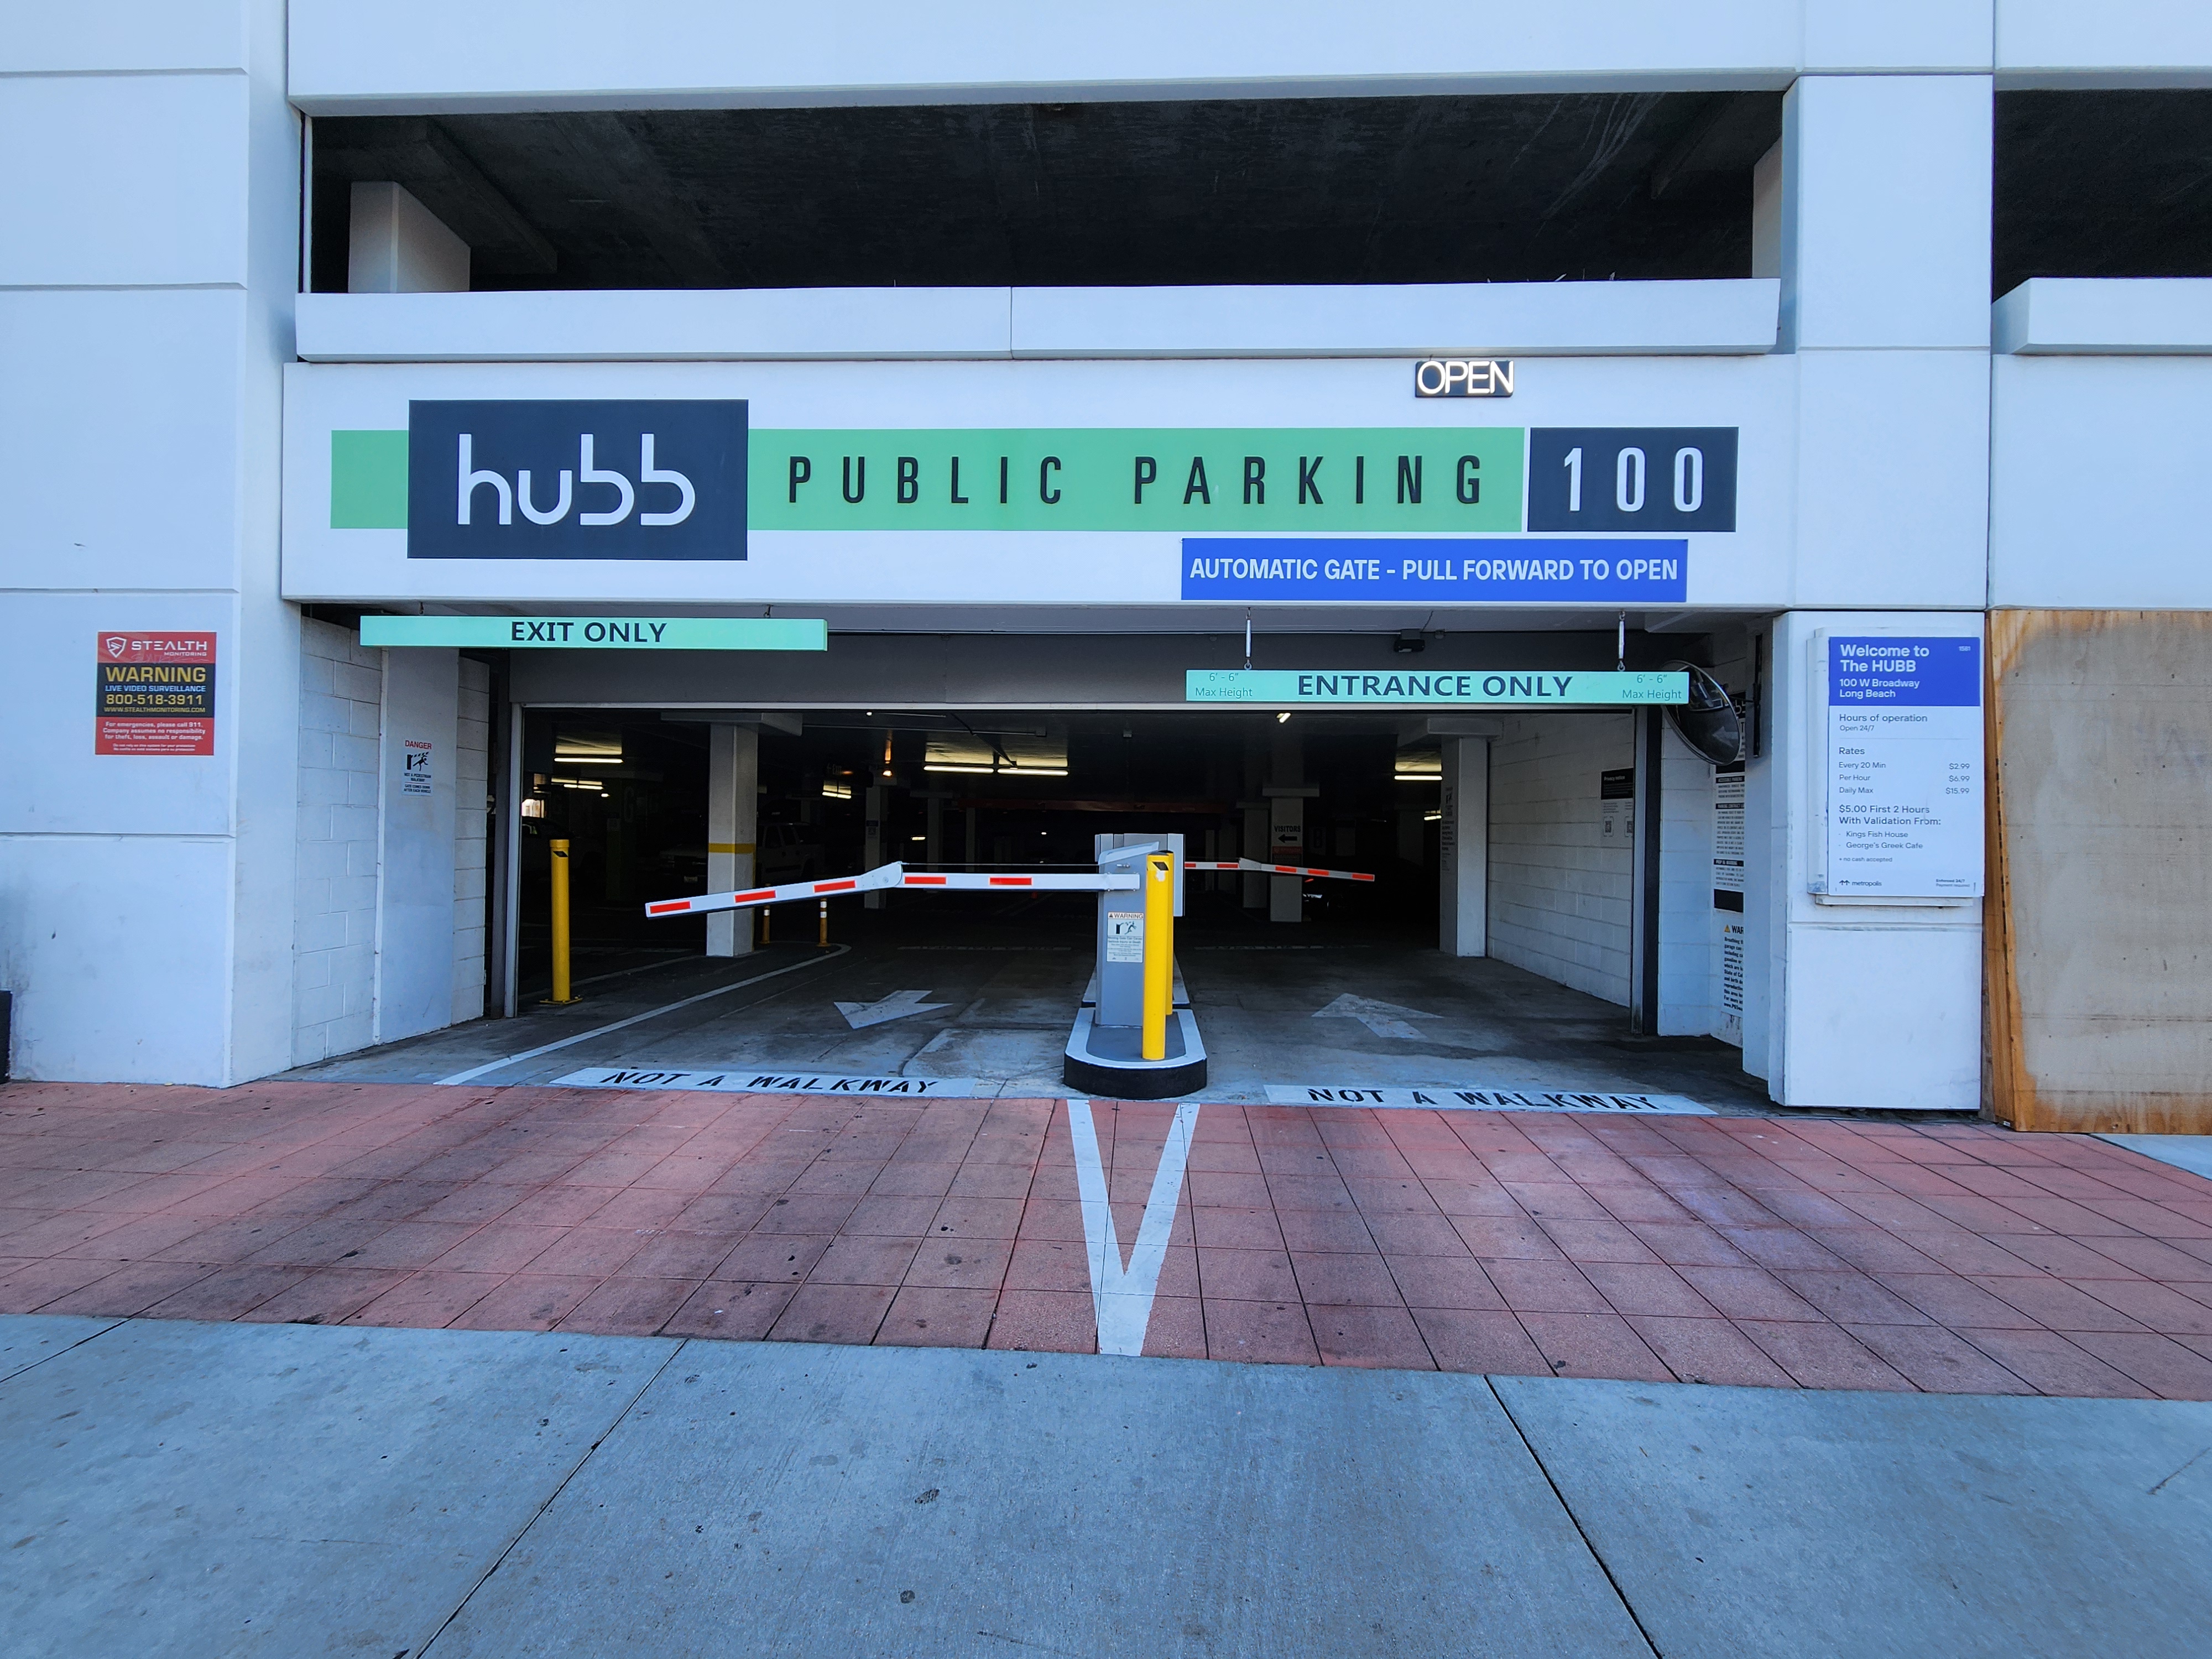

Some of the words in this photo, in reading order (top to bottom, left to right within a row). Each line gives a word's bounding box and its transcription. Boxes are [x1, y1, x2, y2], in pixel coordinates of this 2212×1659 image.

[1416, 360, 1514, 395] OPEN
[458, 433, 696, 526] hubb
[789, 456, 1062, 504] PUBLIC
[1136, 455, 1480, 504] PARKING
[1563, 447, 1703, 513] 100
[1190, 559, 1317, 580] AUTOMATIC
[1324, 559, 1380, 580] GATE
[1402, 559, 1457, 580] PULL
[1463, 559, 1574, 581] FORWARD
[1579, 560, 1610, 581] TO
[1616, 560, 1678, 581] OPEN
[511, 621, 574, 642] EXIT
[584, 622, 667, 643] ONLY
[131, 641, 207, 650] STEALTH
[1840, 645, 1910, 657] Welcome
[1914, 646, 1929, 657] to
[1840, 660, 1868, 671] The
[1872, 660, 1916, 671] HUBB
[105, 666, 206, 682] WARNING
[1298, 675, 1471, 697] ENTRANCE
[1483, 675, 1573, 697] ONLY
[1872, 679, 1920, 688] Broadway
[106, 694, 202, 705] 800-518-3911
[1220, 688, 1252, 699] Height
[1623, 690, 1644, 698] Max
[1647, 689, 1682, 701] Height
[1839, 690, 1863, 699] Long
[1882, 714, 1928, 723] operation
[405, 740, 432, 749] DANGER
[1839, 805, 1866, 813] $5.00
[599, 1072, 691, 1084] NOT
[697, 1075, 726, 1086] A
[747, 1077, 941, 1094] WALKWAY
[1307, 1088, 1385, 1103] NOT
[1412, 1091, 1438, 1105] A
[1453, 1091, 1661, 1110] WALKWAY
